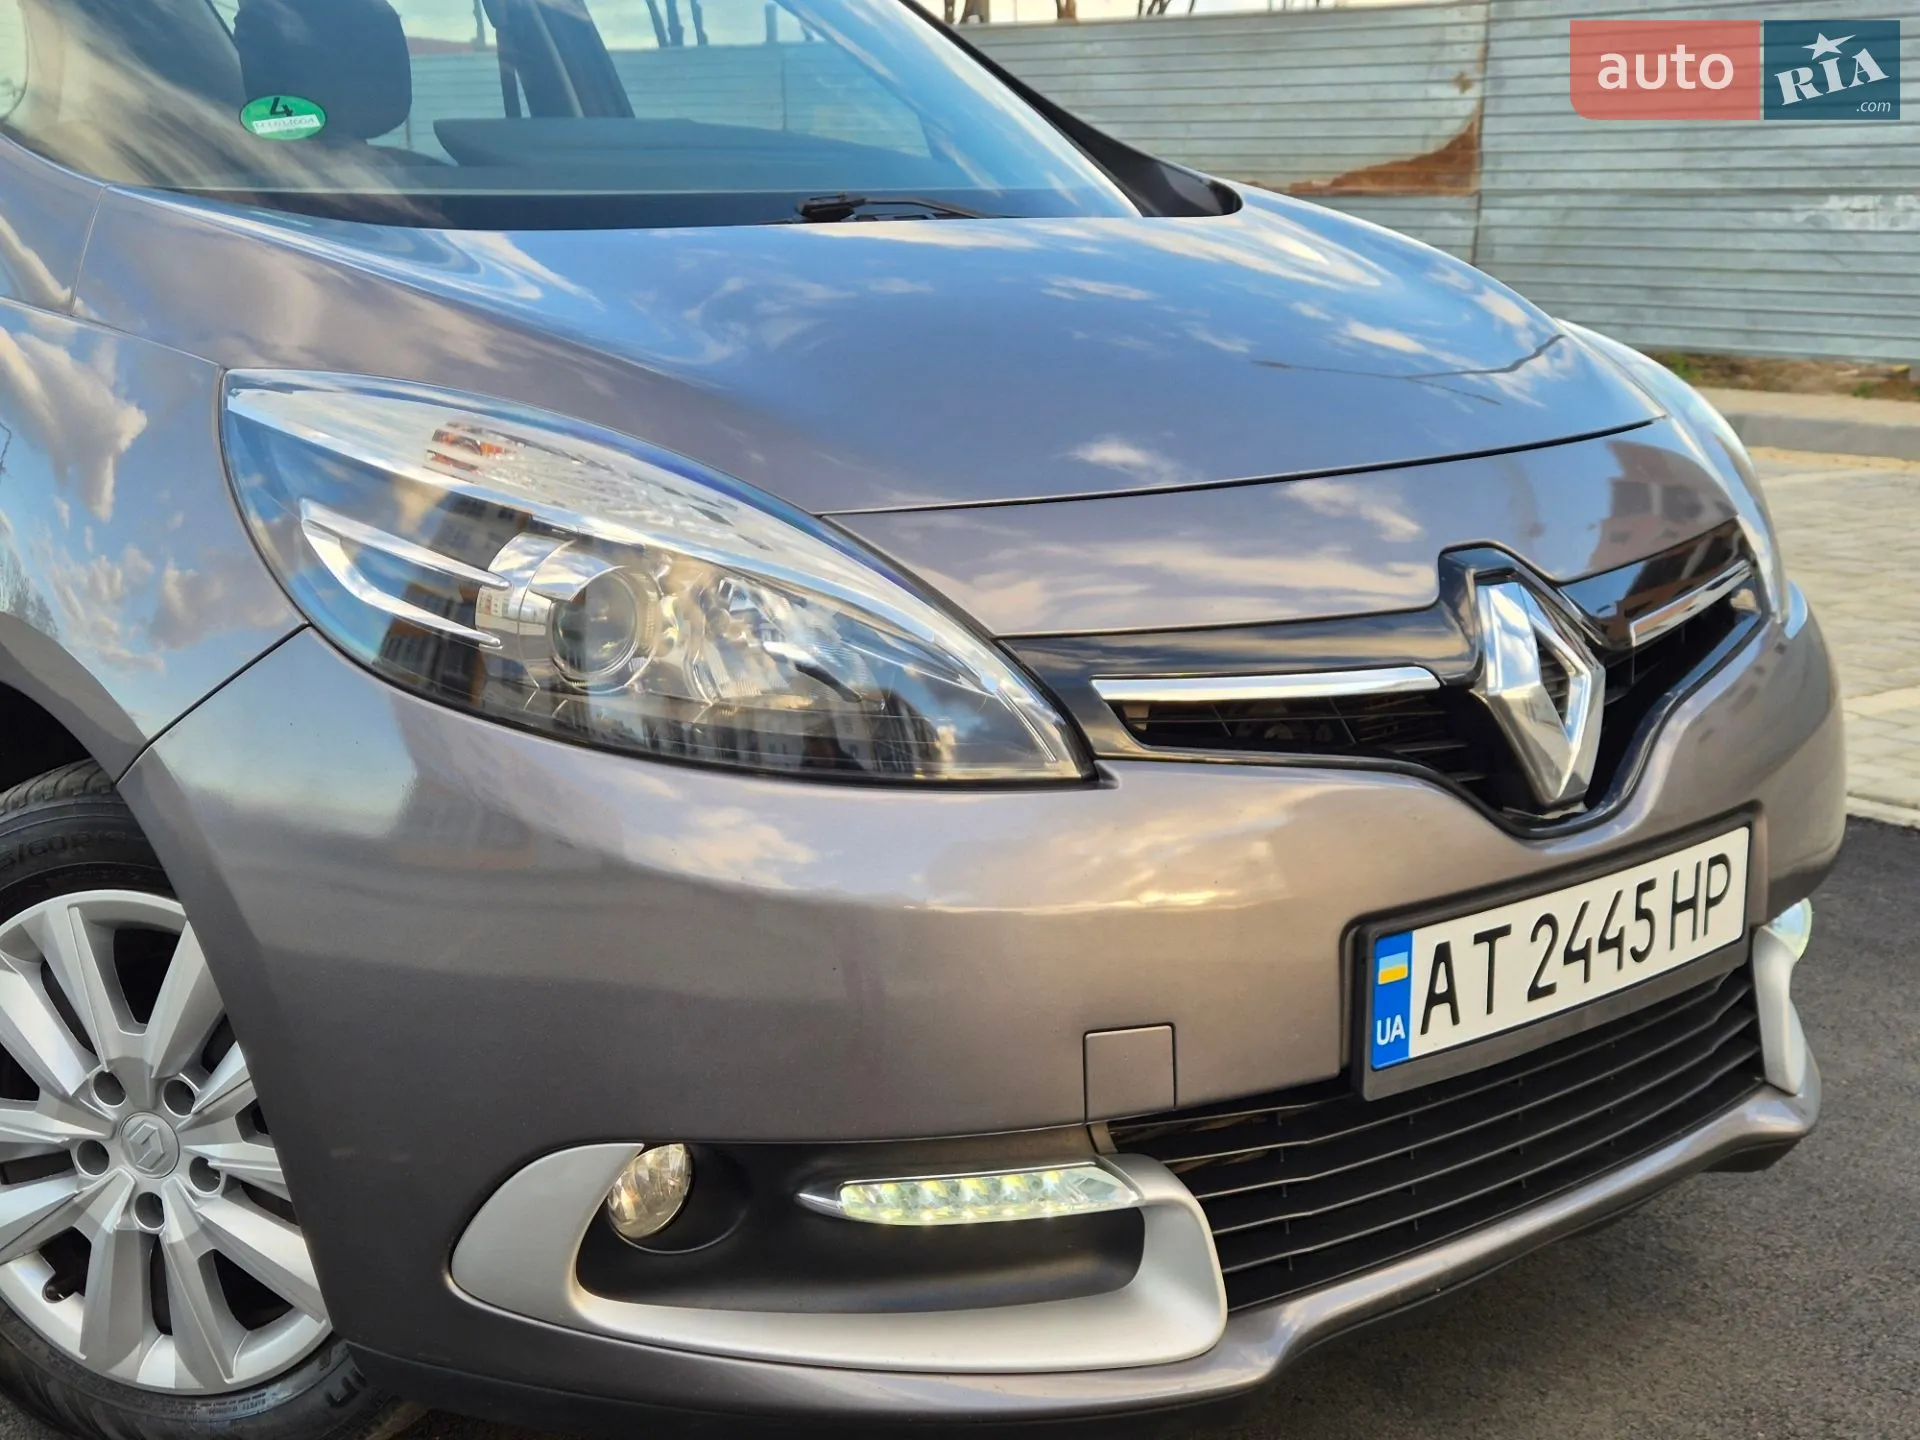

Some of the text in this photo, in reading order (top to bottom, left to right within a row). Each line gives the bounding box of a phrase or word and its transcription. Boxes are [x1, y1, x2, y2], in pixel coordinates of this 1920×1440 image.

[269, 96, 294, 117] 4
[1420, 852, 1732, 1037] AT 2445 HP
[1376, 1014, 1406, 1046] UA
